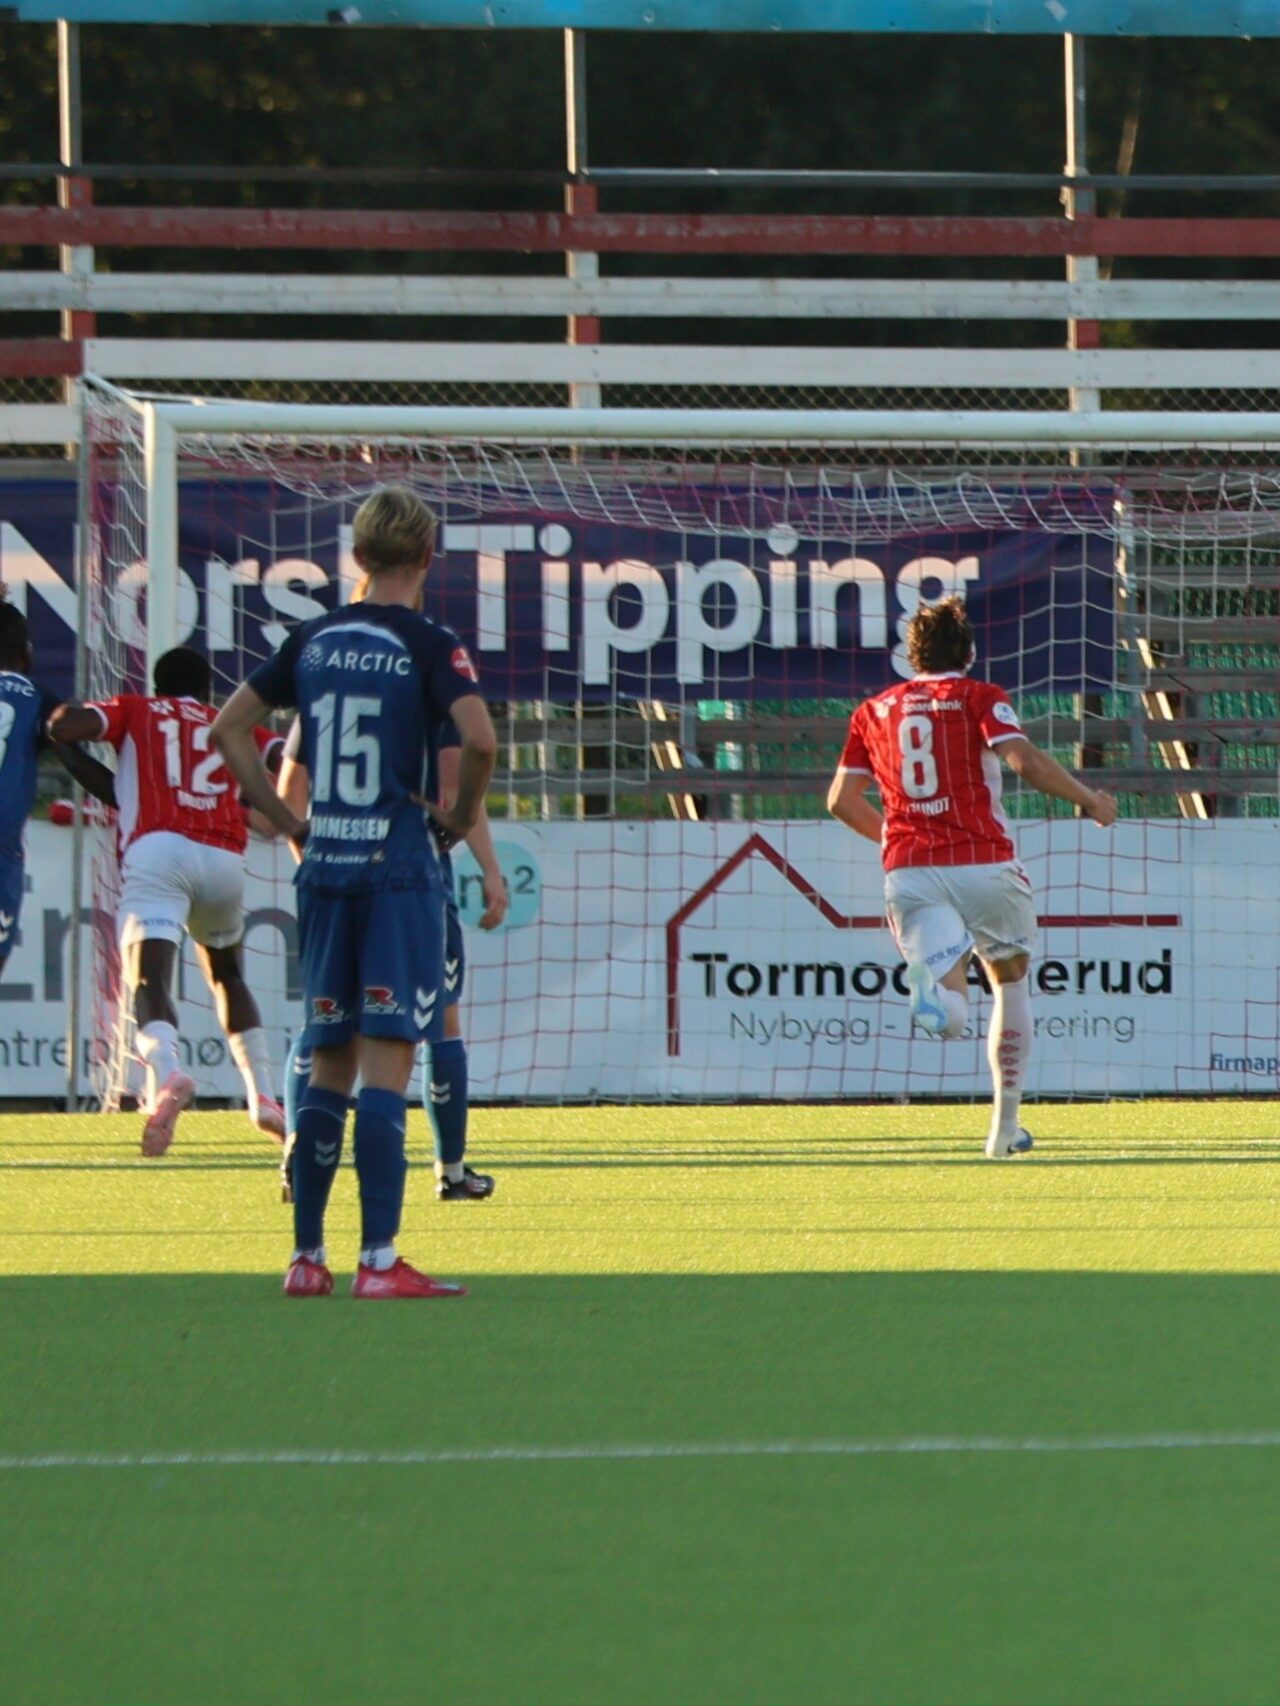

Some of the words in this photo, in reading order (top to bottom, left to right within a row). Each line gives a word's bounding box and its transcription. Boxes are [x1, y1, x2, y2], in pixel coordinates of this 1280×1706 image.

[0, 521, 371, 651] Nors
[326, 651, 411, 676] ARCTIC
[157, 718, 230, 795] 12
[310, 692, 382, 807] 15
[898, 715, 939, 799] 8
[966, 948, 1172, 995] Aerud
[730, 1010, 870, 1046] Nybygg
